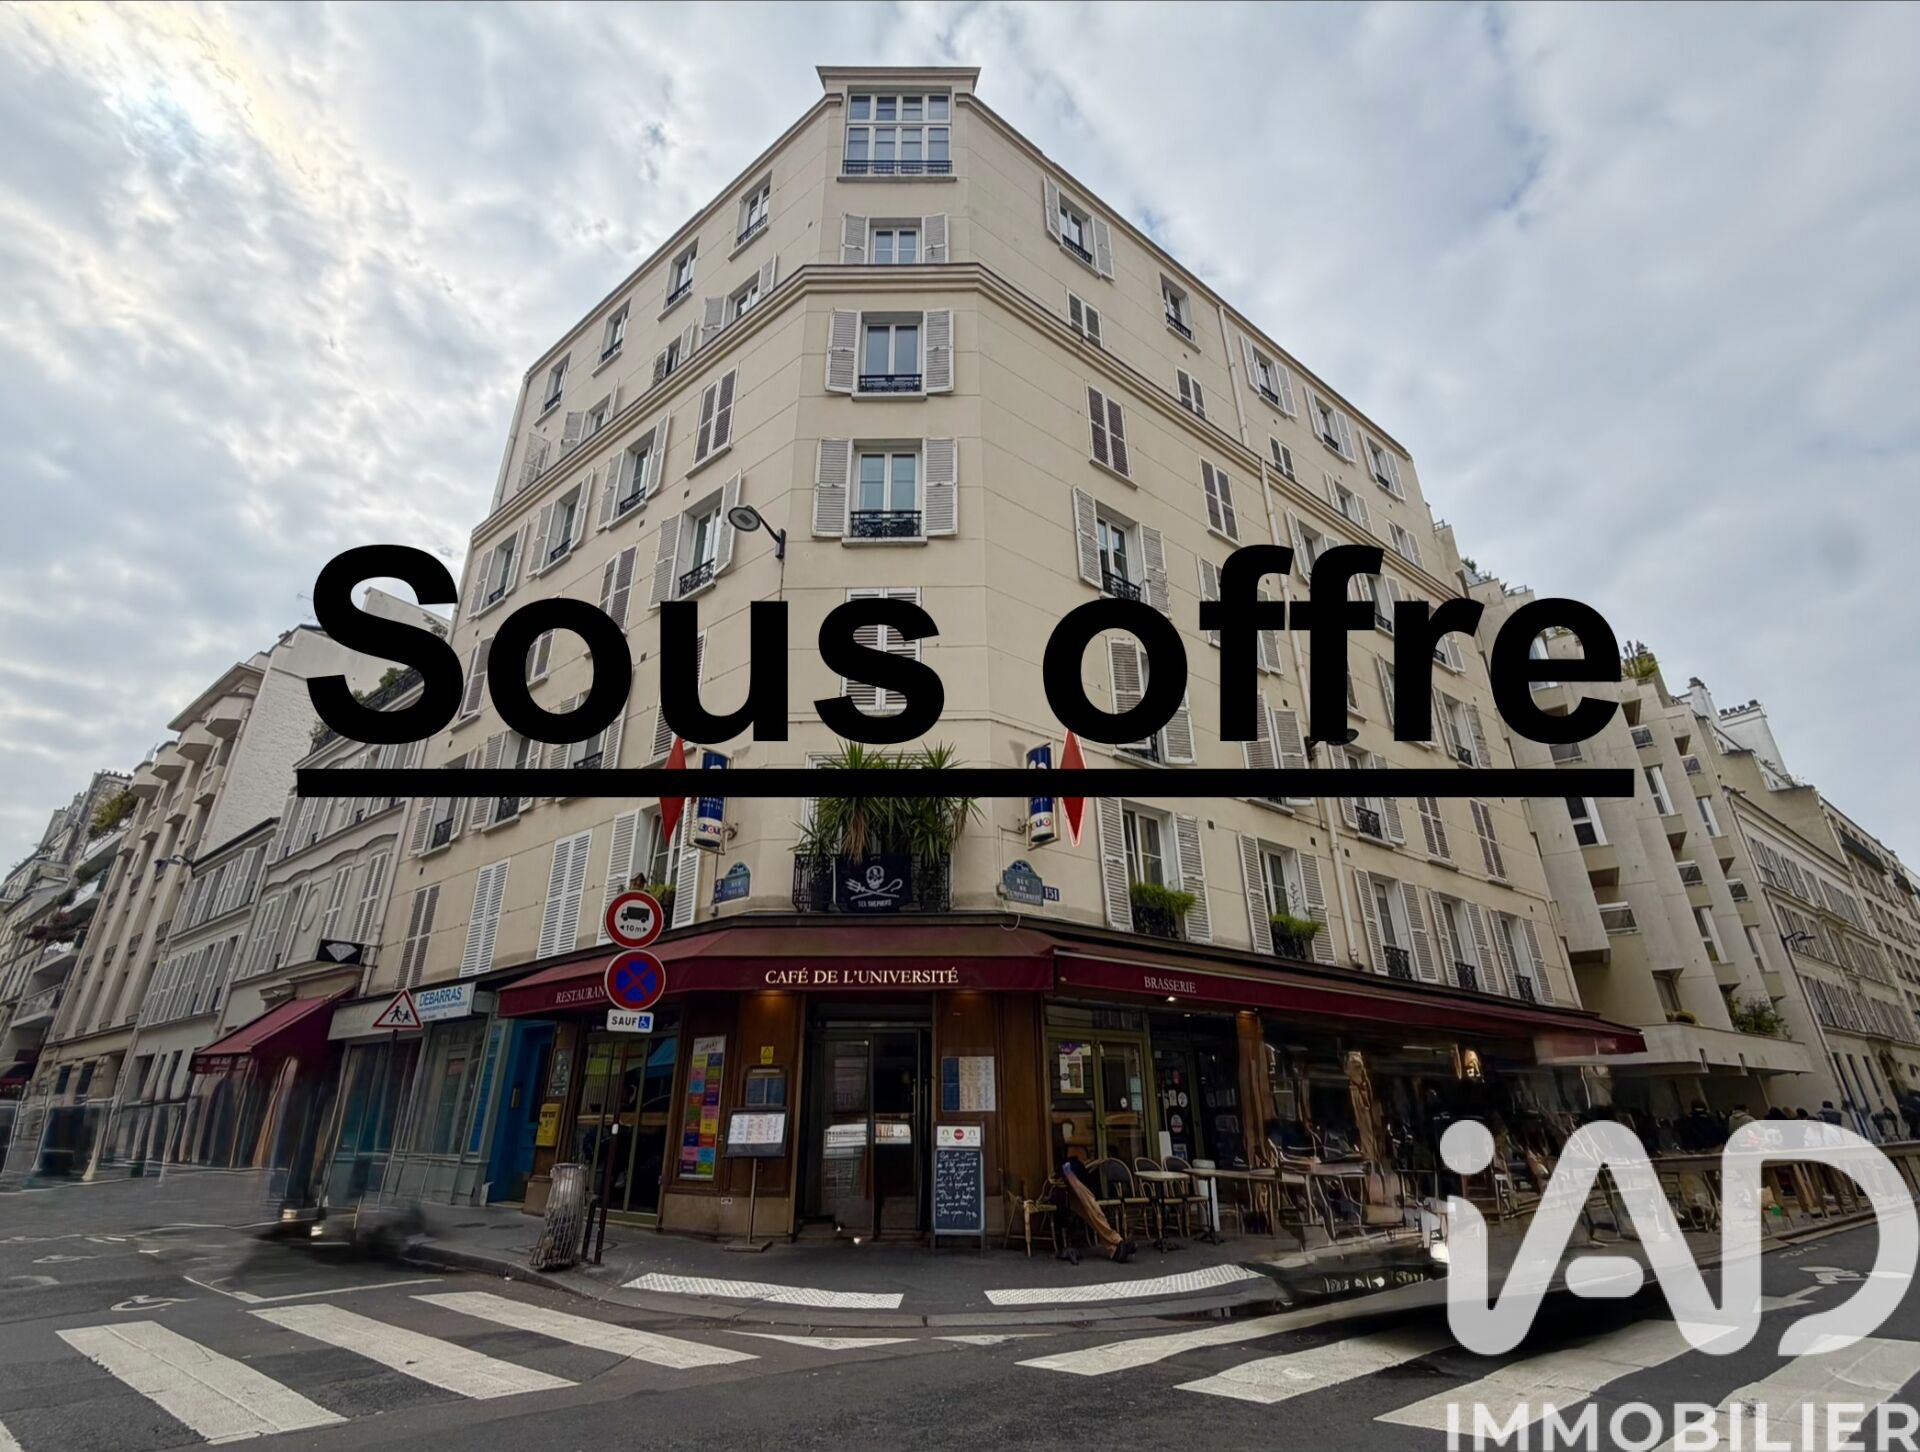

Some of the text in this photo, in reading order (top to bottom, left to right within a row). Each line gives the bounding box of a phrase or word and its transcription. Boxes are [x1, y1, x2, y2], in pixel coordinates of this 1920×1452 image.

[1045, 887, 1058, 900] 151
[765, 967, 959, 984] CAFÉ DE L'UNIVERSITÉ
[1143, 976, 1197, 994] BRASSERIE
[555, 985, 607, 1004] RESTAURAN
[611, 1015, 637, 1026] SAUF
